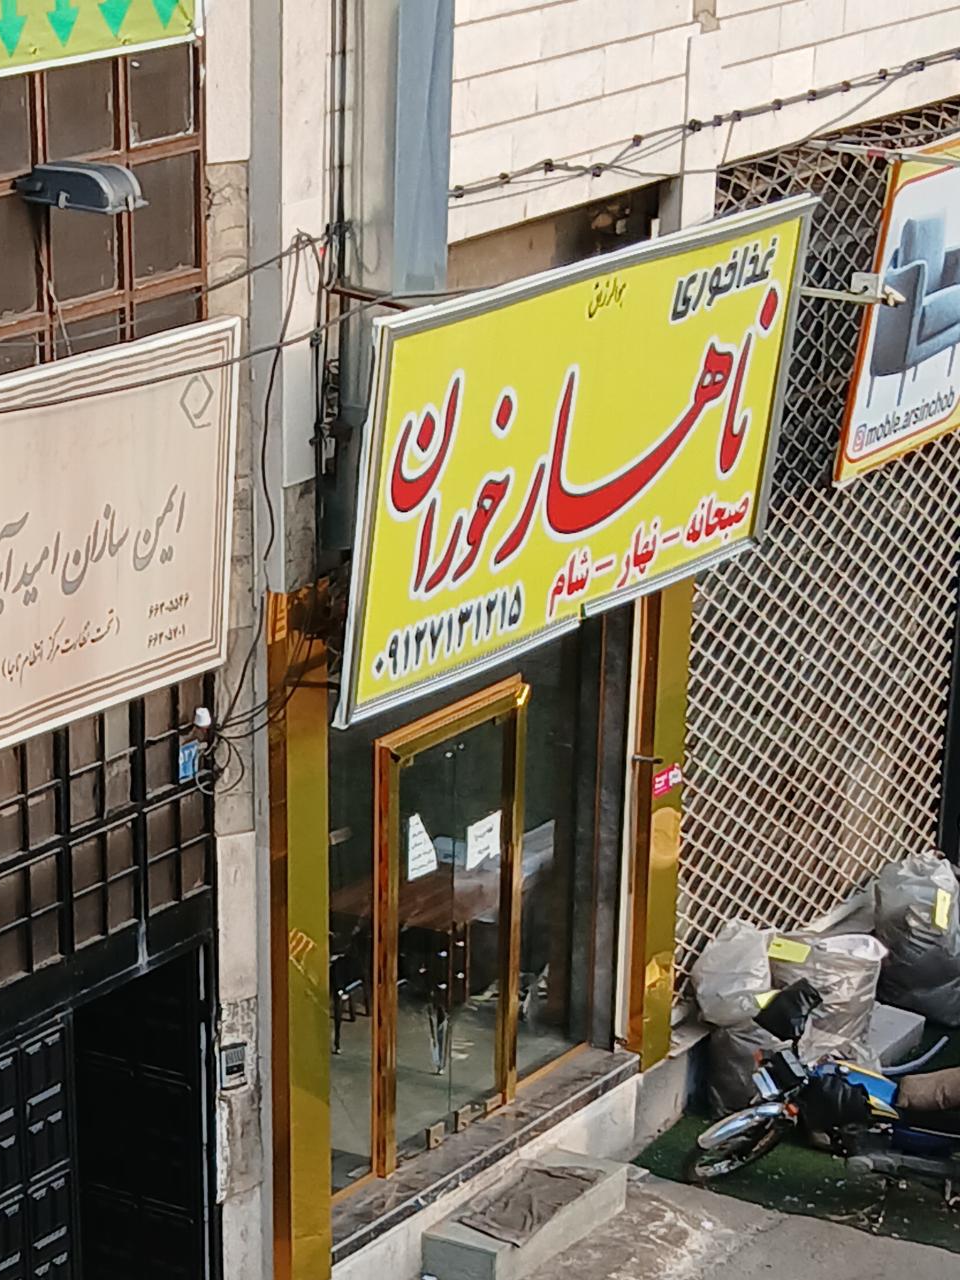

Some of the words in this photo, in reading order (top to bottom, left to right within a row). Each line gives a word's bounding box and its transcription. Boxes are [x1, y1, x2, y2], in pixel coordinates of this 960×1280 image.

[669, 237, 778, 323] غذاخوری
[61, 503, 129, 596] سازان
[133, 484, 187, 572] ایمن
[617, 523, 661, 589] نهار
[685, 494, 751, 545] صبحانه
[11, 531, 61, 606] امید
[546, 550, 589, 619] شام
[374, 585, 522, 675] ۰۹۱۲۷۱۳۱۲۱۵
